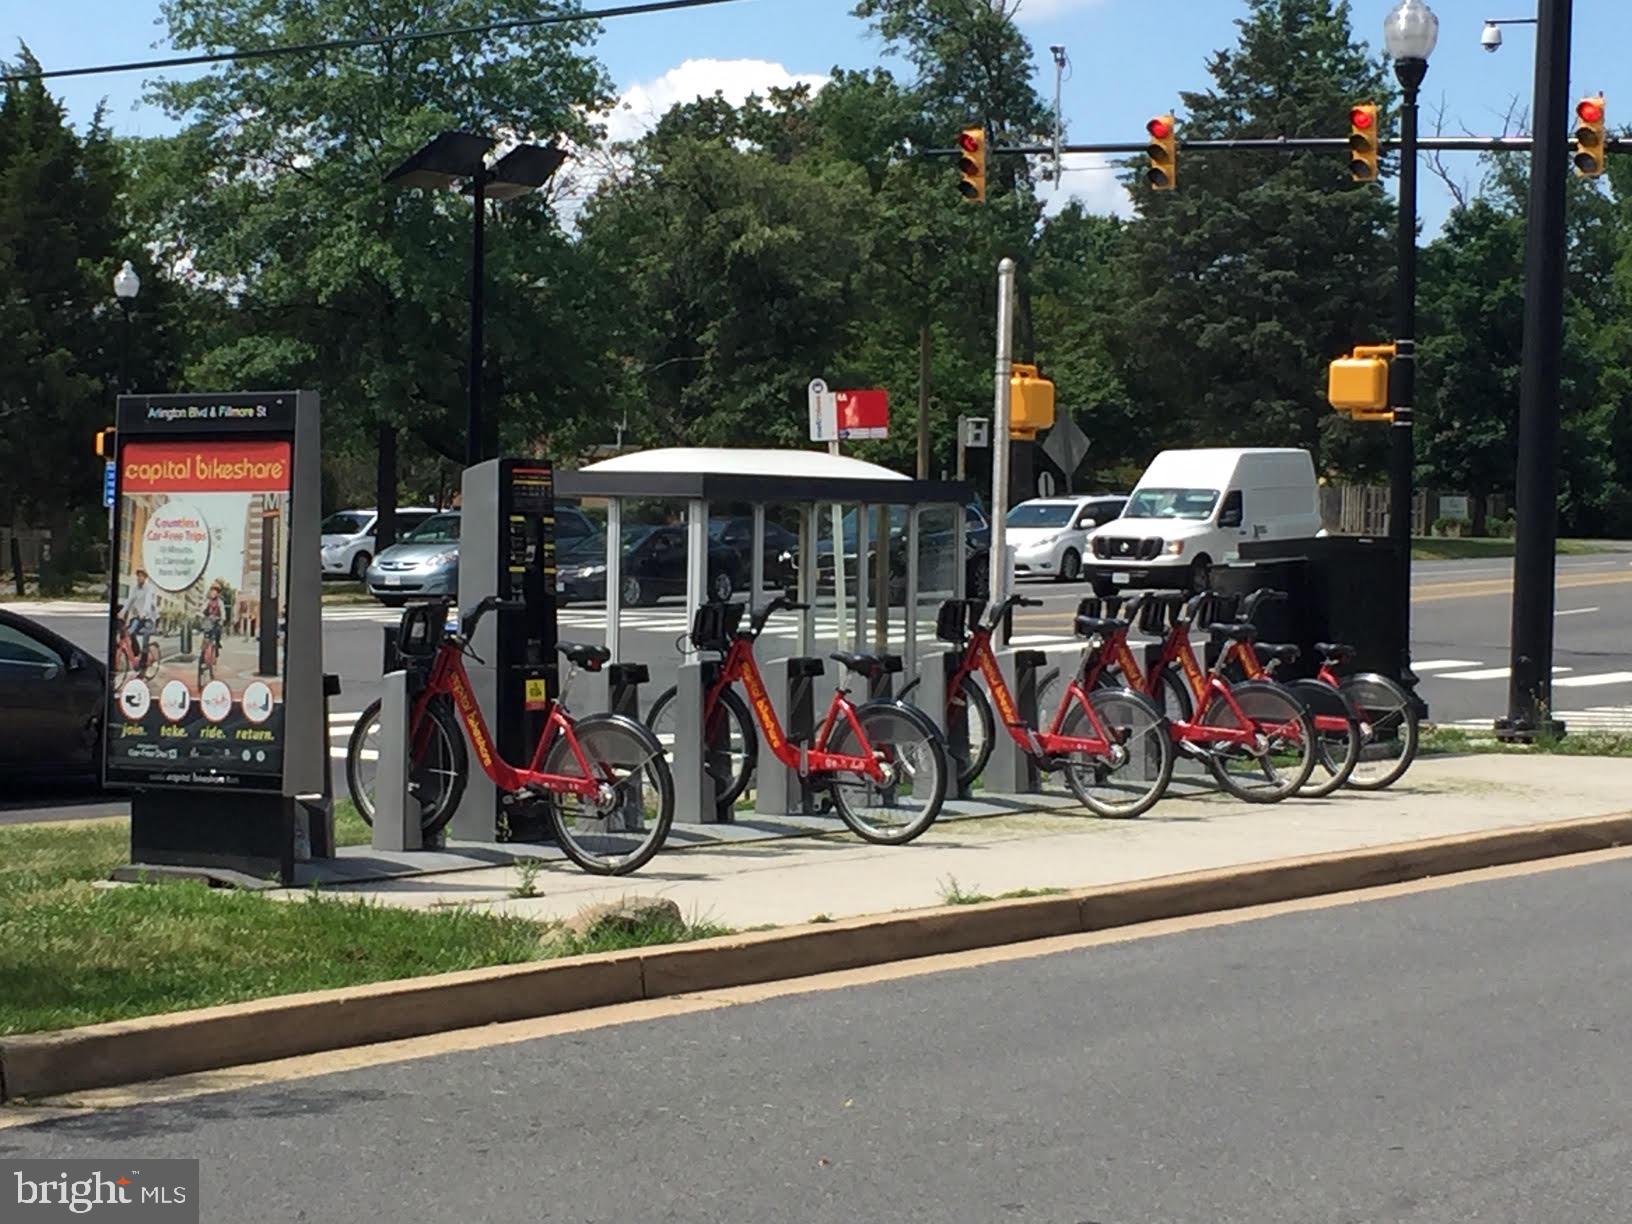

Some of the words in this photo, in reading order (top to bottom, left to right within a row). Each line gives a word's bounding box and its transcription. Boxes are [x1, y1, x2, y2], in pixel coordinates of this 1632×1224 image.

[188, 406, 209, 419] Blvd
[209, 405, 218, 418] &
[256, 405, 267, 417] St
[125, 457, 191, 485] capital
[196, 454, 283, 480] bikeshare
[120, 724, 148, 738] join.
[160, 725, 188, 738] take.
[200, 726, 226, 739] ride.
[235, 728, 275, 741] return.
